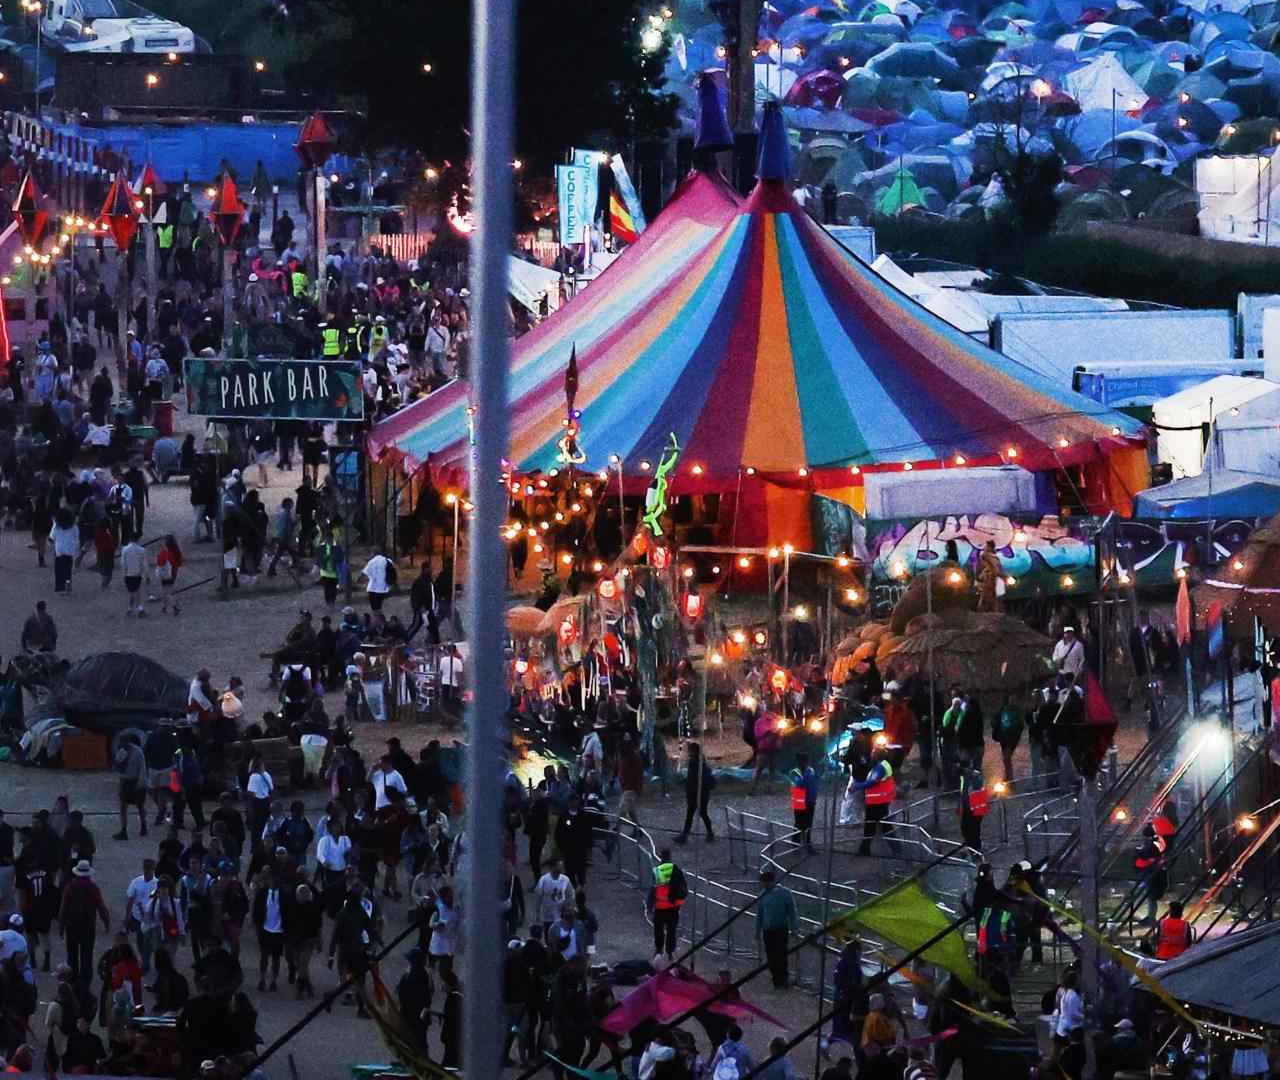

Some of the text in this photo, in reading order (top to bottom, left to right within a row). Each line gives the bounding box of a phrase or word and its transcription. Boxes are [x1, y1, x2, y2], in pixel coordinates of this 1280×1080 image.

[567, 170, 576, 239] COFFEE
[220, 365, 329, 409] PARK BAR
